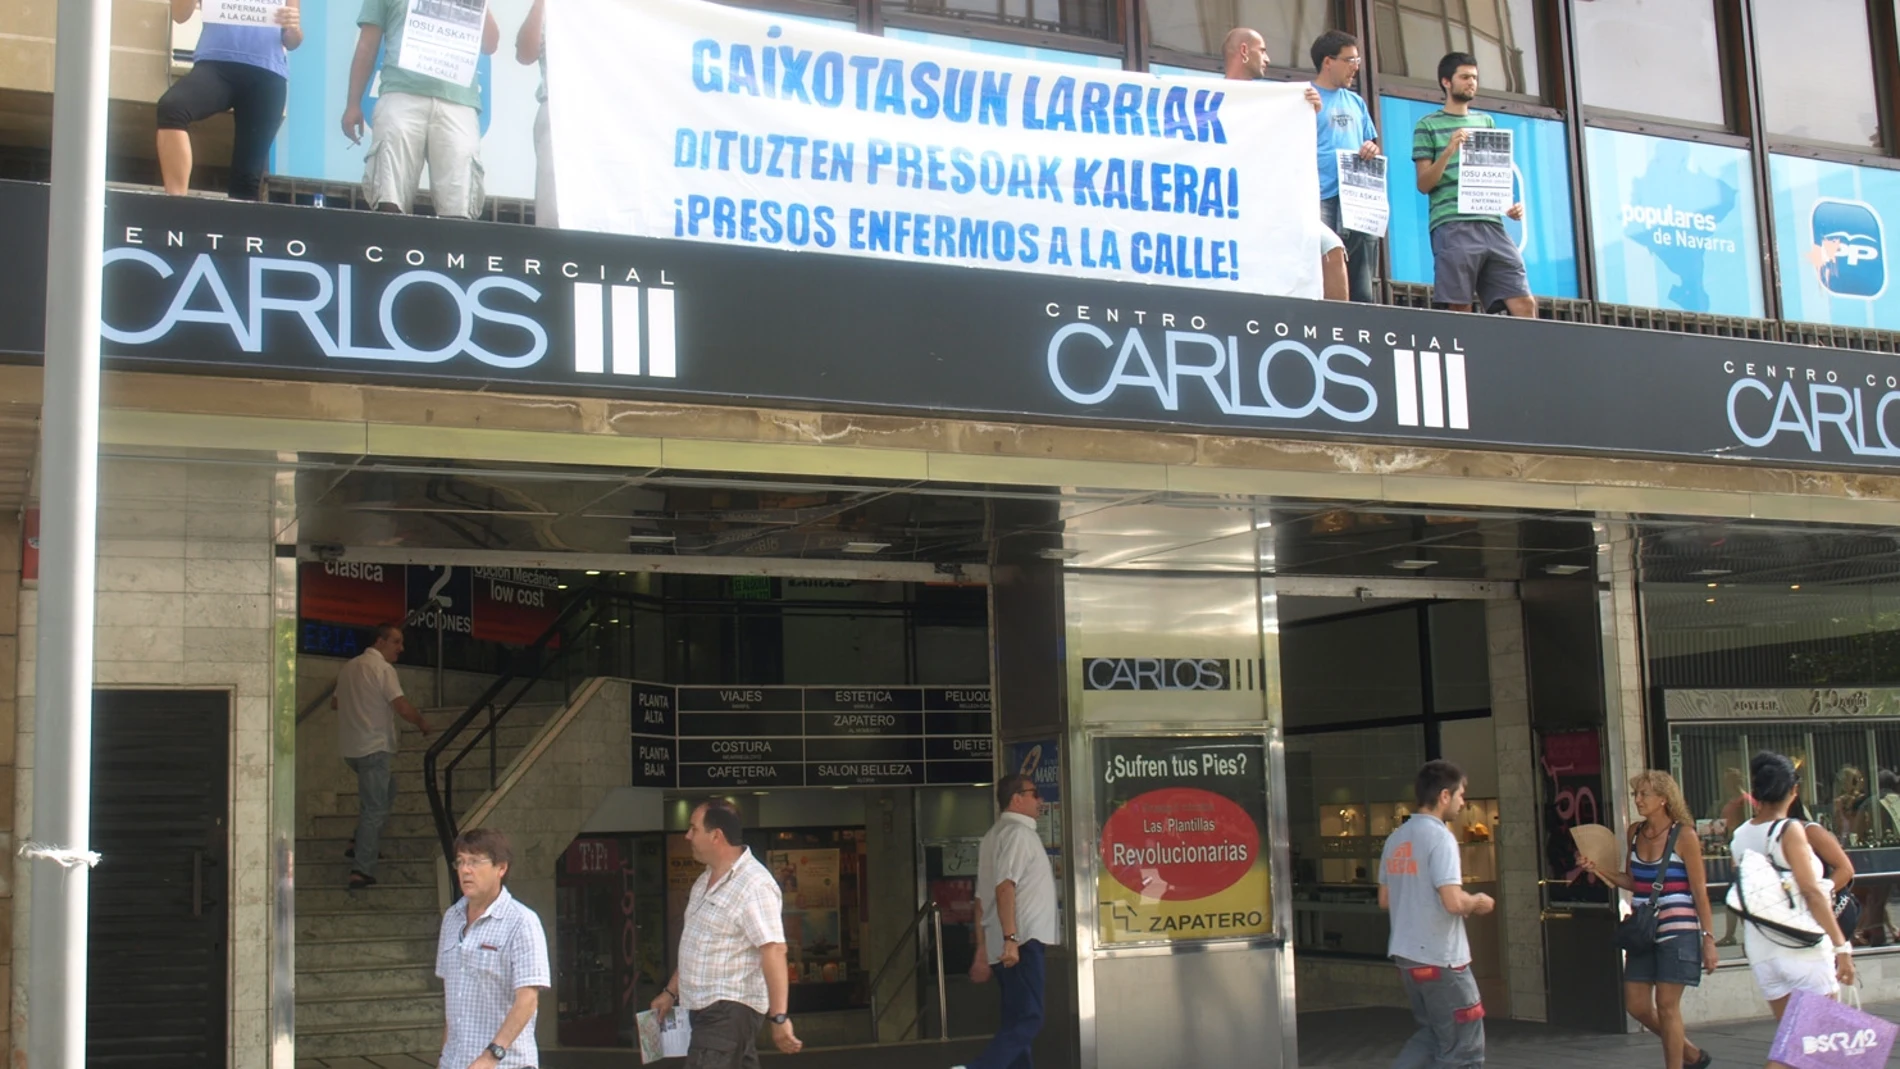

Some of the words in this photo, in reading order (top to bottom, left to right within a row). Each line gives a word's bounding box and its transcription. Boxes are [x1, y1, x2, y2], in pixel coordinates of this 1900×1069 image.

[221, 2, 267, 13] ENFERMAS
[240, 14, 267, 22] CALLE
[409, 19, 435, 33] IOSU
[437, 26, 479, 43] ASKATU
[1022, 75, 1227, 144] LARRIAK
[674, 128, 854, 183] DITUZTEN
[867, 138, 1063, 203] PRESOAK
[1073, 157, 1239, 219] KALERA!
[1621, 203, 1717, 232] populares
[850, 208, 1039, 263] ENFERMOS
[1048, 226, 1072, 266] A
[1081, 227, 1121, 270] LA
[1131, 232, 1239, 281] CALLE!
[1653, 227, 1672, 246] de
[1676, 230, 1736, 253] Navarra
[125, 226, 307, 257] ENTRO
[365, 246, 676, 286] COMERCIAL
[100, 246, 549, 369] CARLOS
[574, 282, 677, 378] III
[1046, 302, 1207, 330] CENTRO
[1246, 319, 1465, 352] COMERCIAL
[1047, 322, 1379, 423] CARLOS
[1393, 348, 1470, 430] III
[1723, 360, 1838, 383] CENTRO
[428, 565, 453, 607] 2
[490, 579, 514, 604] low
[517, 587, 545, 609] cost
[1088, 658, 1224, 691] CARLOS
[638, 692, 669, 709] PLANTA
[720, 690, 763, 702] VIAJES
[835, 690, 893, 702] ESTETICA
[644, 710, 664, 724] ALTA
[833, 714, 896, 727] ZAPATERO
[639, 746, 669, 761] PLANTA
[711, 741, 772, 753] COSTURA
[953, 739, 993, 752] DIETET
[644, 762, 665, 777] BAJA
[707, 765, 777, 778] CAFETERIA
[818, 765, 858, 777] SALON
[861, 764, 913, 777] BELLEZA
[1105, 754, 1168, 784] ¿Sufren
[1171, 756, 1198, 777] tus
[1202, 752, 1248, 777] Pies?
[1143, 819, 1162, 833] Las
[1167, 817, 1216, 832] Plantillas
[1113, 838, 1248, 866] Revolucionarias
[1149, 910, 1263, 933] ZAPATERO
